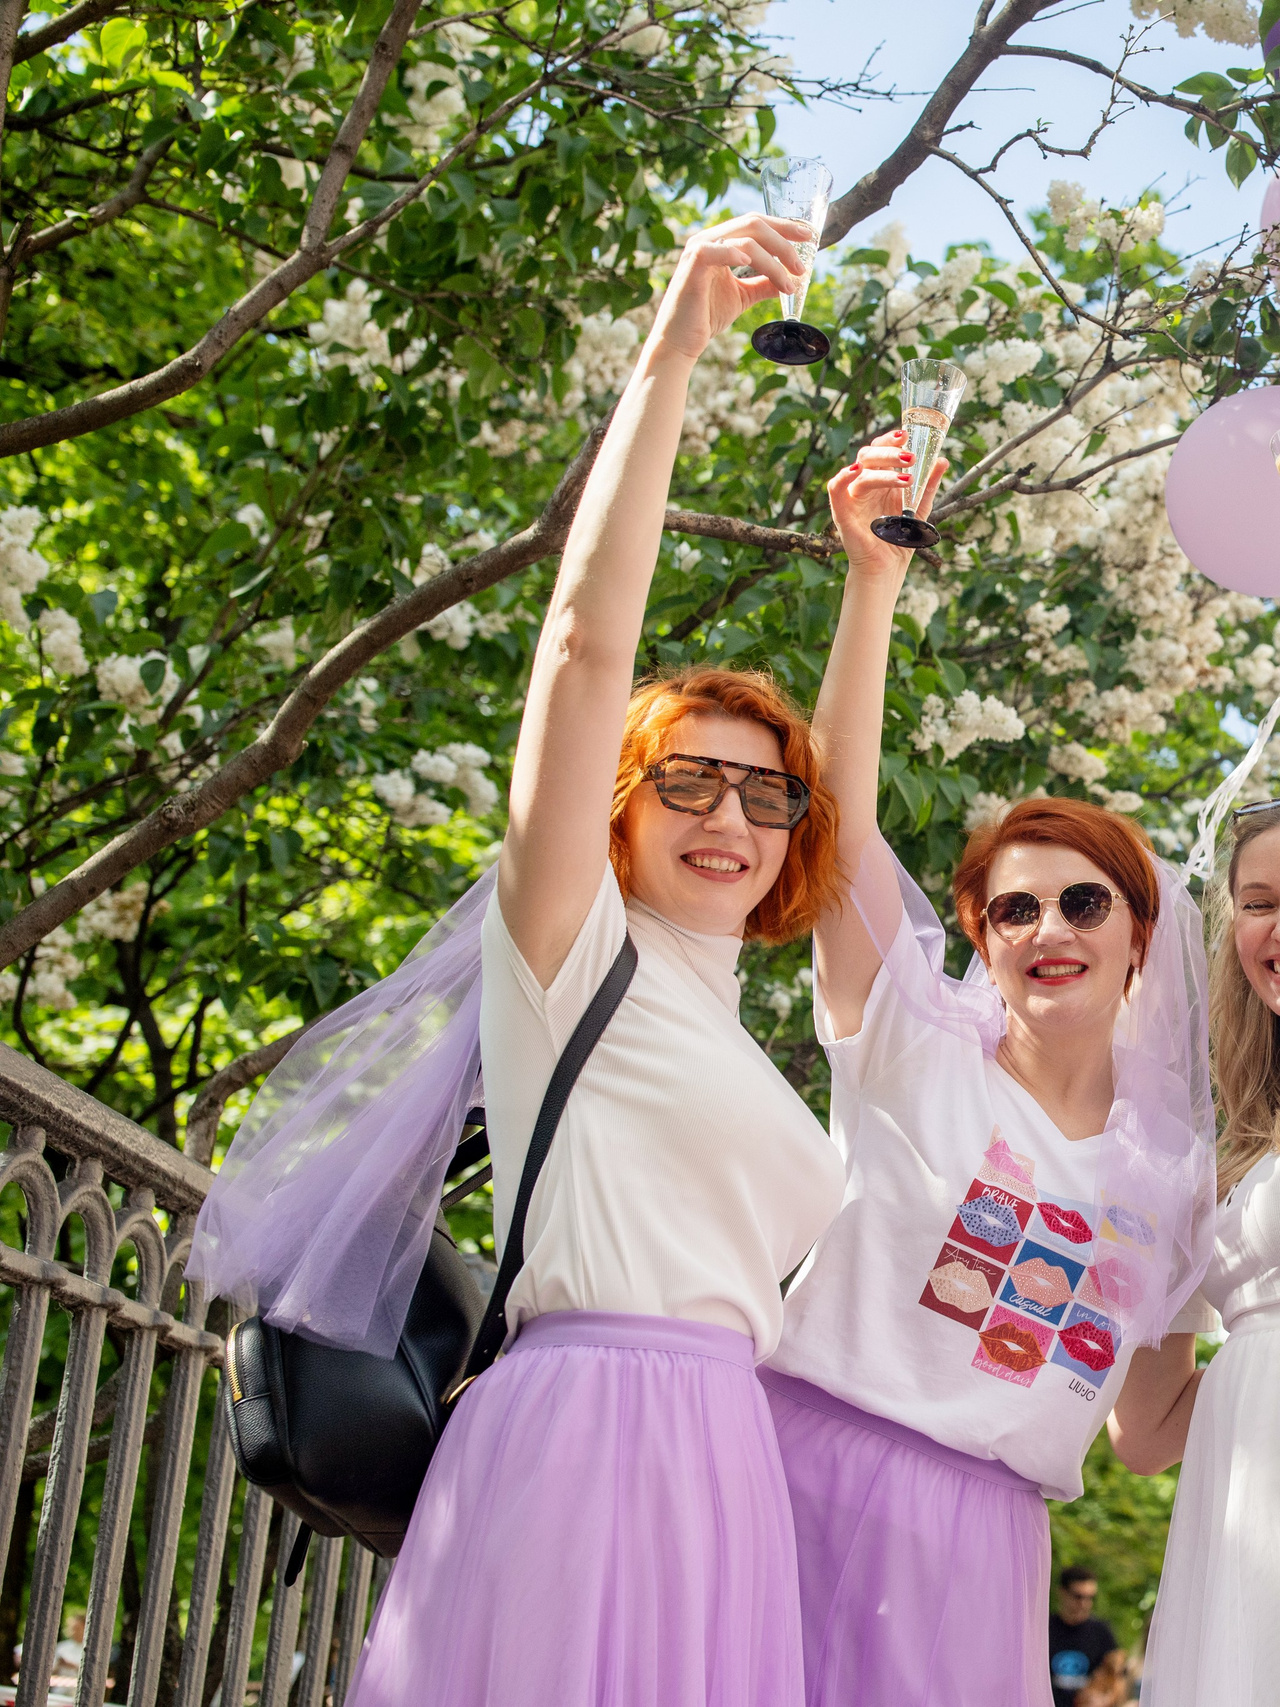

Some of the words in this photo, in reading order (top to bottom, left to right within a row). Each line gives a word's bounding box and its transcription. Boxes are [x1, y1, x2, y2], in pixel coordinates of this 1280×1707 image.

[981, 1186, 1021, 1212] BRAVE
[973, 1358, 1005, 1377] good
[1004, 1370, 1033, 1387] day
